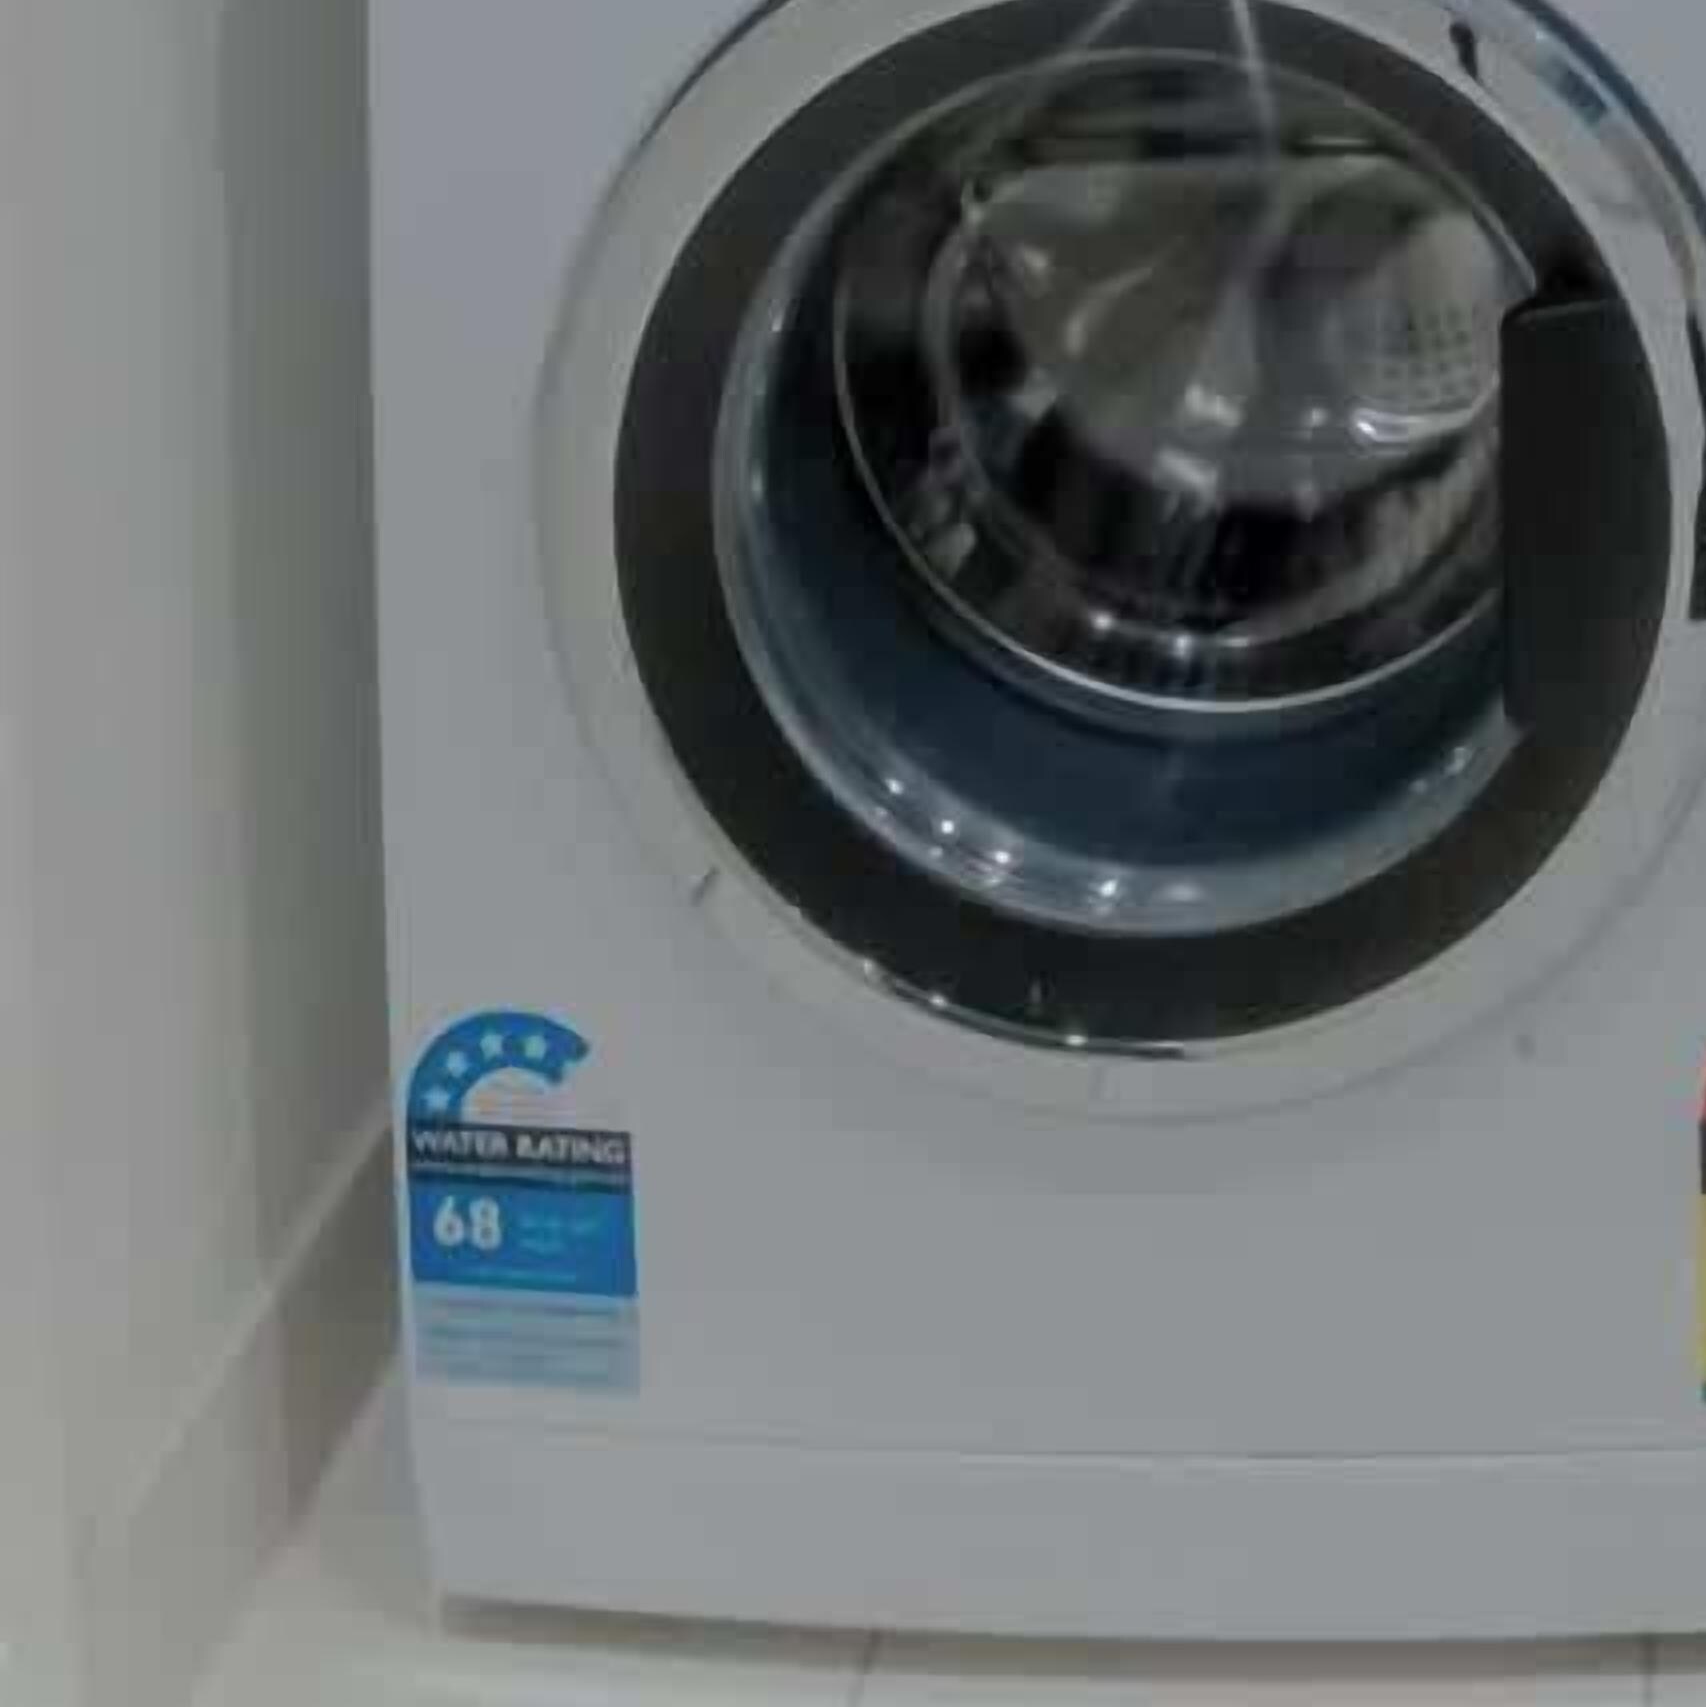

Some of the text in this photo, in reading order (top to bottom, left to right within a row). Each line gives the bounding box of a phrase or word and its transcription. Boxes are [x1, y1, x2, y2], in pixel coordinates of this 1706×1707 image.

[412, 1130, 625, 1165] WATER RATING
[432, 1194, 503, 1251] 68
